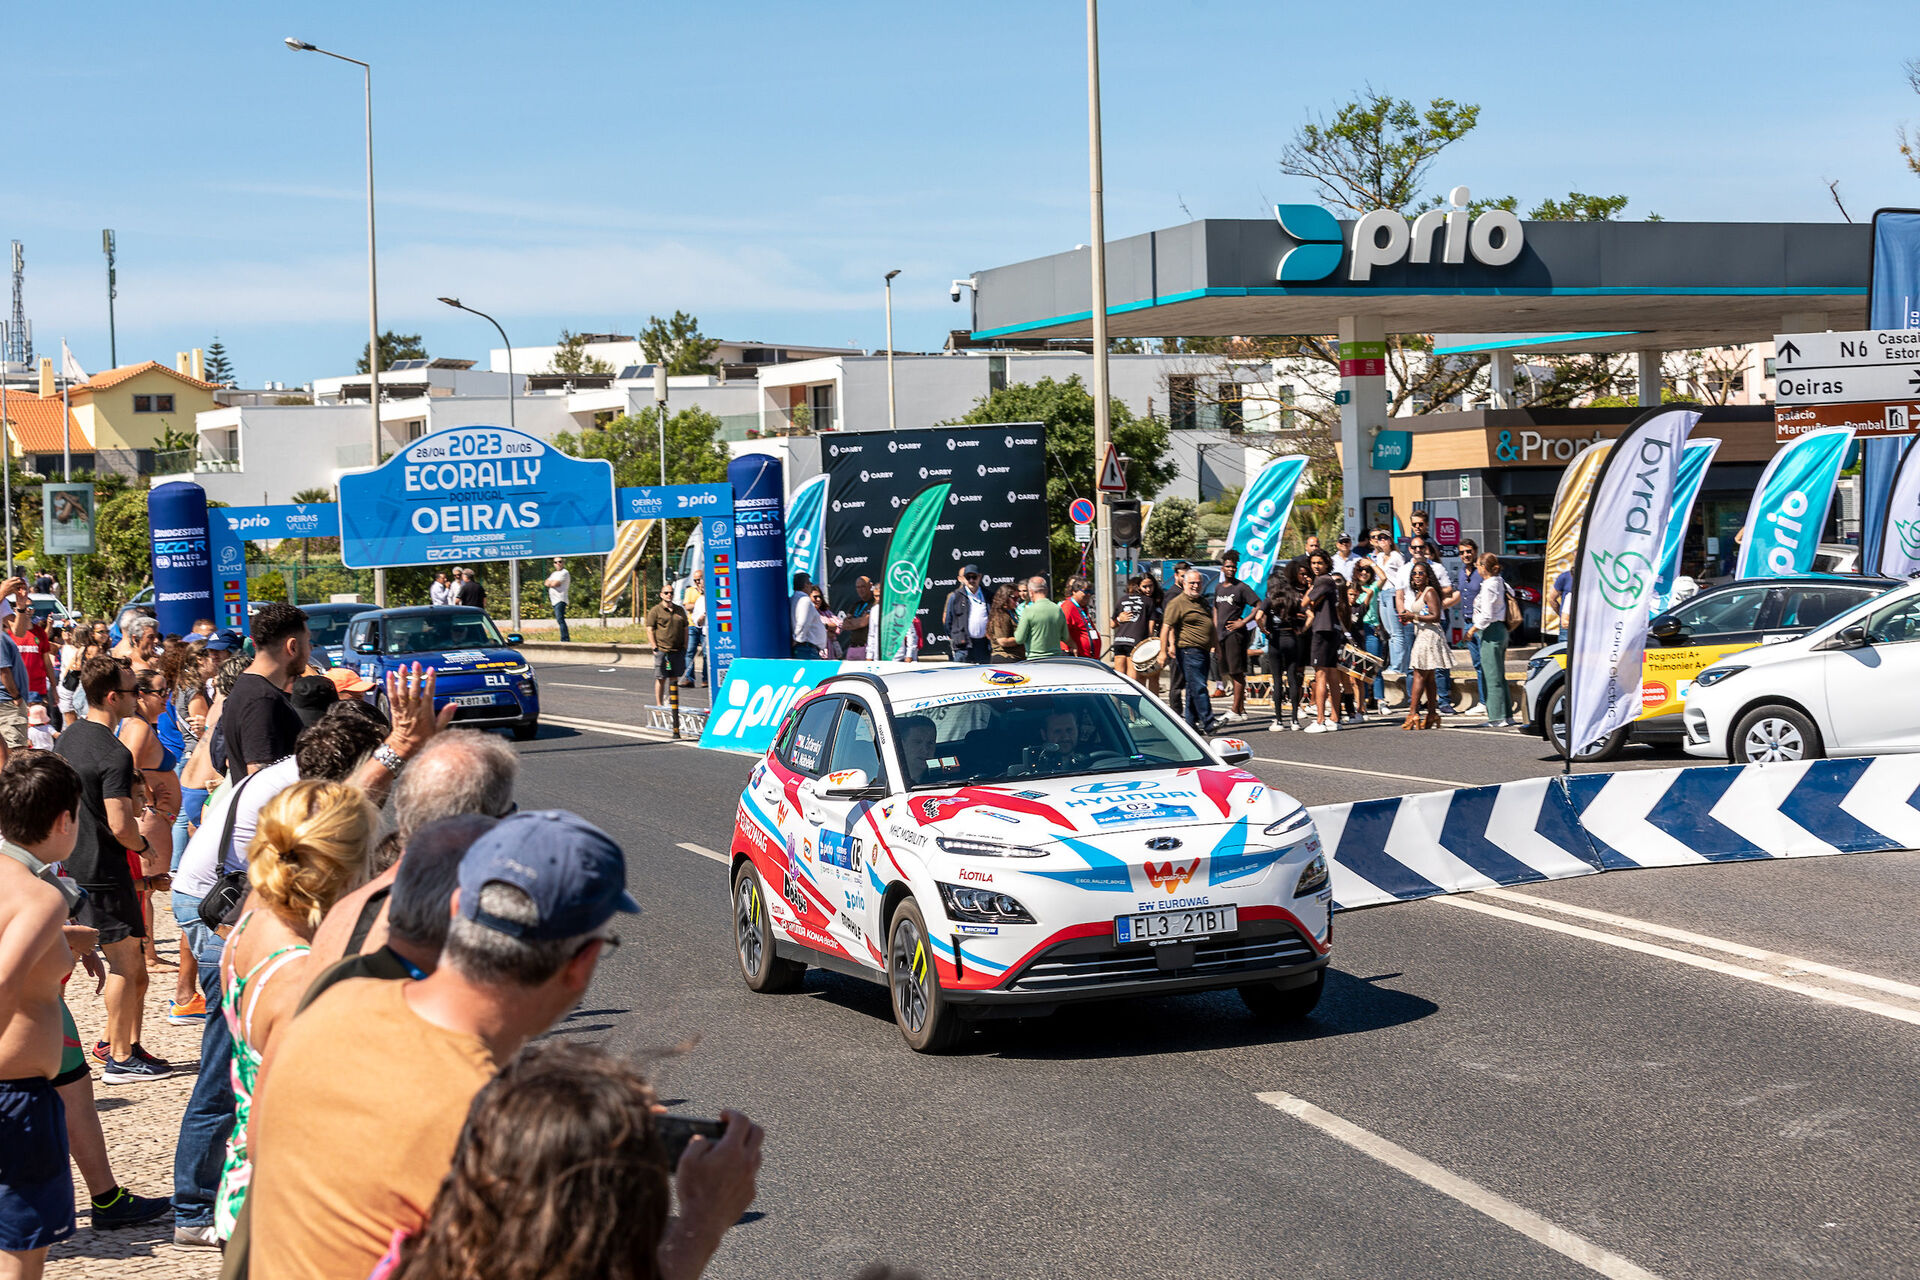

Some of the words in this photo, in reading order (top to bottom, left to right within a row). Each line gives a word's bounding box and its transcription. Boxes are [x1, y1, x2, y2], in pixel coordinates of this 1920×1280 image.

[1348, 185, 1524, 280] prio
[1840, 341, 1849, 358] N
[1859, 340, 1868, 356] 6
[1778, 378, 1843, 396] Oeiras
[1777, 410, 1816, 422] palácio
[416, 448, 446, 458] 28/04
[448, 434, 502, 456] 2023
[506, 443, 532, 454] 01/05
[1384, 442, 1401, 458] prio
[404, 459, 541, 492] ECORALLY
[1625, 437, 1670, 536] byrd
[450, 490, 504, 502] PORTUGAL
[632, 498, 662, 506] OEIRAS
[689, 492, 717, 508] prio
[286, 514, 318, 522] OEIRAS
[412, 502, 540, 534] OEIRAS
[632, 506, 662, 514] VALLEY
[240, 514, 270, 530] prio
[286, 522, 318, 531] VALLEY
[1246, 498, 1276, 561] prio
[1440, 524, 1456, 534] MB
[1766, 490, 1808, 575] prio
[708, 536, 732, 546] byrd
[218, 562, 242, 572] byrd
[1610, 621, 1624, 662] going
[484, 674, 510, 686] ELL
[937, 690, 1001, 705] HYUNDAI
[1006, 687, 1068, 696] KONA
[1608, 666, 1618, 719] electric
[1064, 792, 1198, 808] HYUNDAI
[1126, 802, 1152, 812] 03
[900, 827, 928, 848] MOBILITY
[851, 838, 863, 872] 03
[958, 868, 993, 882] FLOTILA
[1154, 872, 1189, 882] LeasePlan
[852, 891, 865, 911] prio
[1158, 896, 1210, 909] EUROWAG
[1134, 916, 1168, 938] EL3
